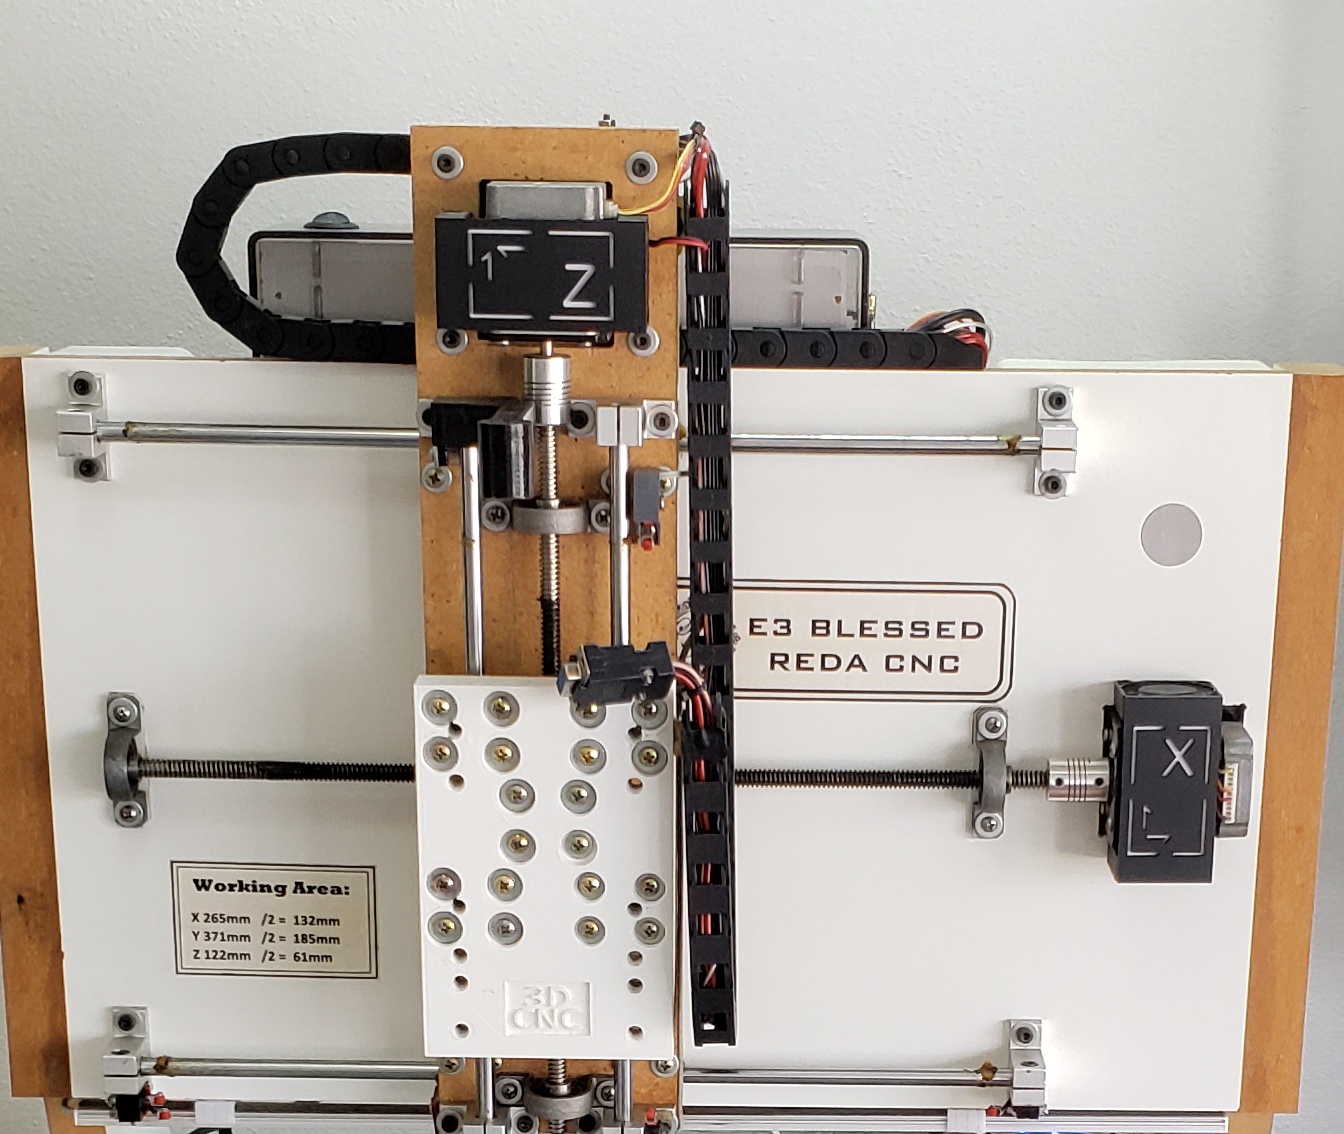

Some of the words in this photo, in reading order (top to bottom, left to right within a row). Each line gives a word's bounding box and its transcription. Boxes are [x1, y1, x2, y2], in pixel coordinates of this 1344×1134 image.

[562, 264, 596, 309] Z
[749, 618, 792, 637] E3
[811, 619, 984, 640] BLESSED
[769, 652, 868, 673] REDA
[884, 654, 960, 674] CNC
[1161, 738, 1195, 778] X
[193, 878, 288, 897] Working
[292, 881, 350, 896] Area:
[191, 912, 200, 923] X
[203, 913, 251, 925] 265mm
[261, 912, 276, 927] /2
[293, 914, 341, 927] 132mm
[192, 931, 200, 942] Y
[203, 931, 251, 943] 371mm
[261, 931, 276, 945] /2
[293, 933, 341, 945] 185mm
[192, 949, 201, 960] Z
[204, 950, 251, 962] 122mm
[261, 949, 276, 964] /2
[293, 951, 333, 964] 61mm
[522, 985, 571, 1008] 3D
[511, 1007, 583, 1030] CNC
